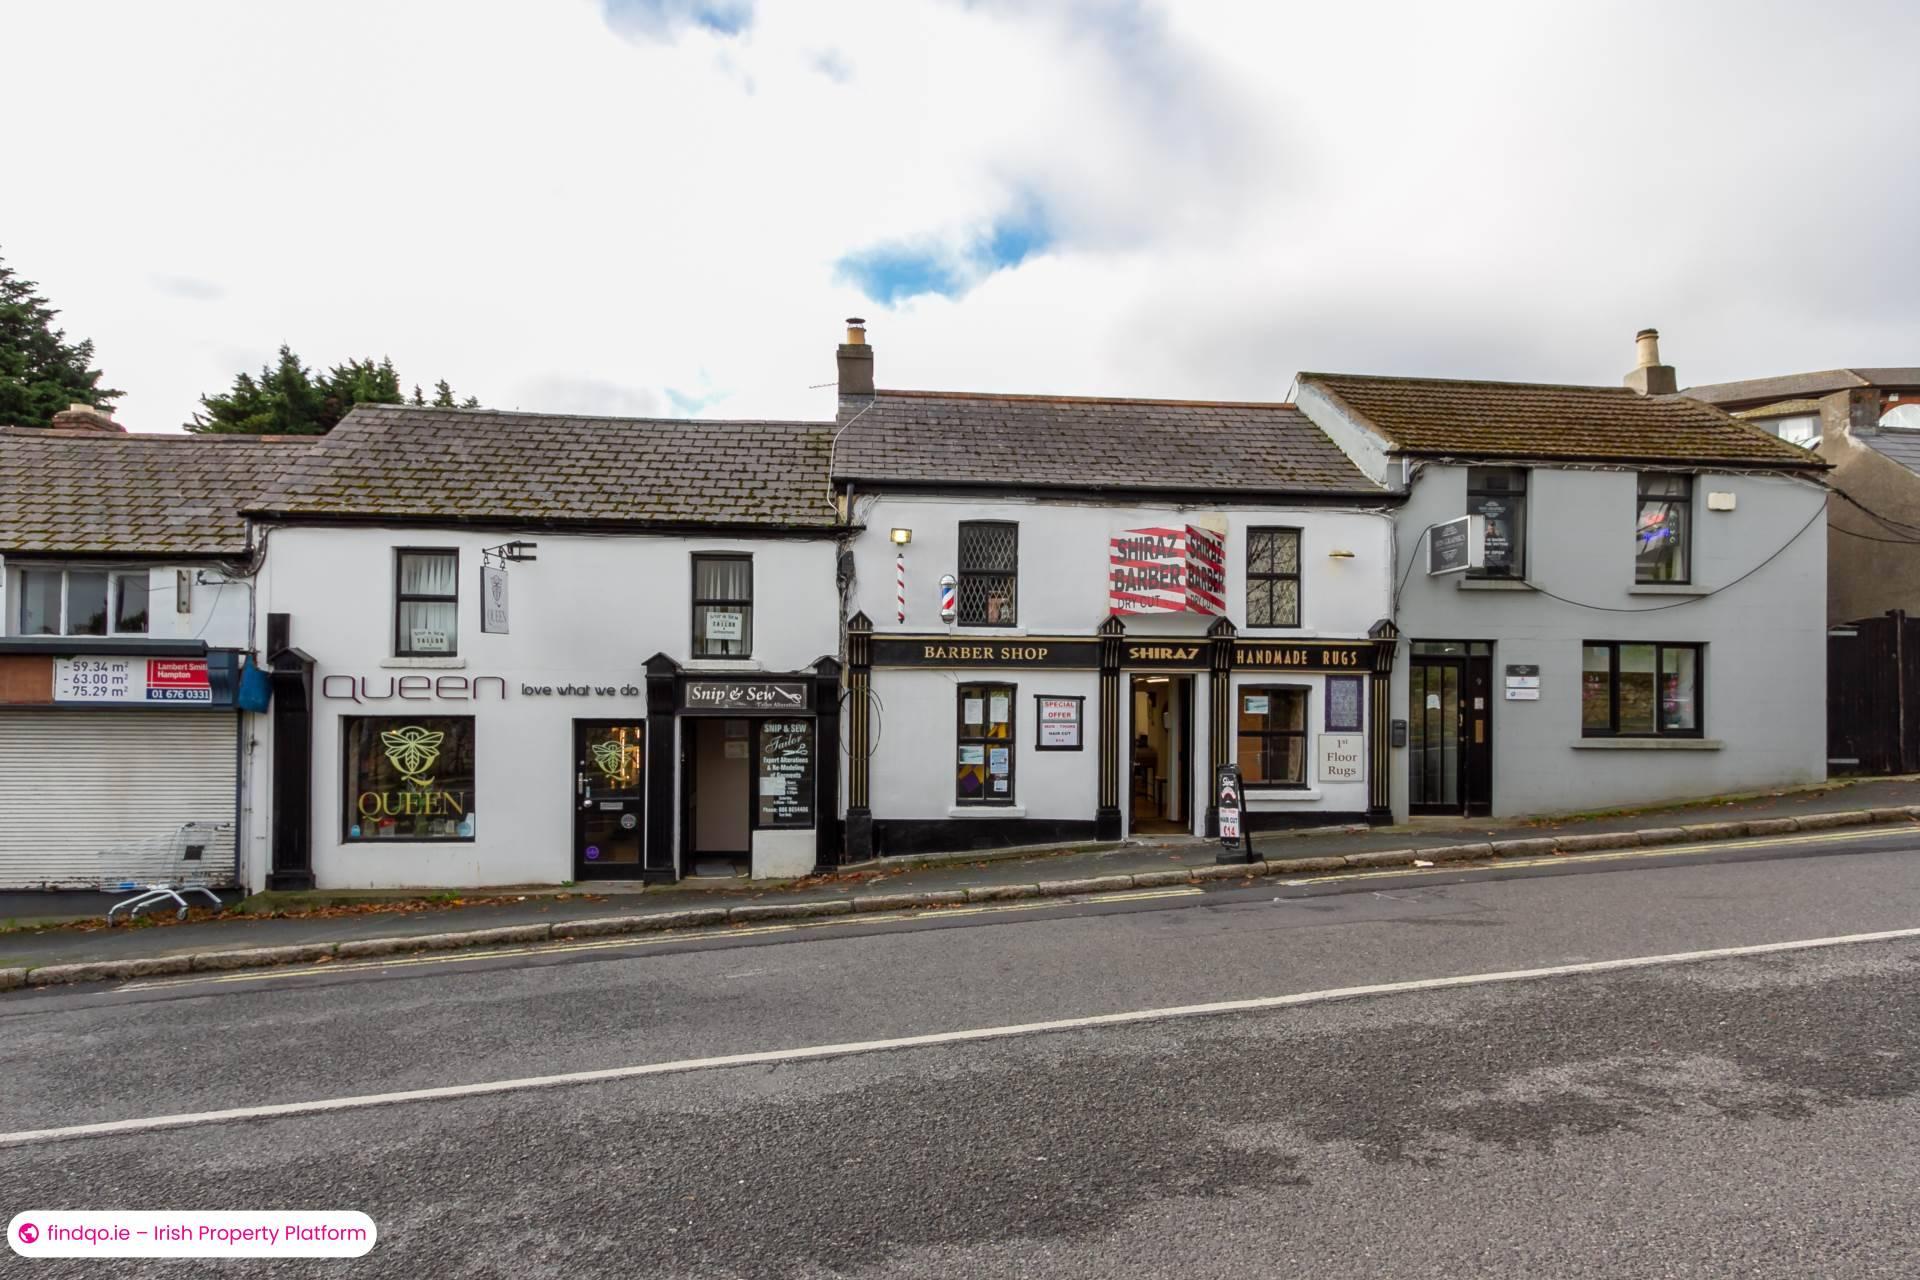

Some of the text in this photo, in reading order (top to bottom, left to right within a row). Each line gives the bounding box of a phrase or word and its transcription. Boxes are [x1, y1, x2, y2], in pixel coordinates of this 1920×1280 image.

[1117, 534, 1178, 561] SHIRAZ
[1190, 535, 1223, 564] SHIRAZ
[1114, 564, 1181, 592] BARBER
[1186, 562, 1225, 593] BARBER
[1118, 595, 1160, 609] DRY CUT
[924, 646, 1048, 660] BARBER SHOP
[1236, 649, 1357, 666] HANDMADE RUGS
[72, 661, 108, 672] 59.34
[157, 663, 188, 671] Lambert
[72, 673, 108, 685] 63.00
[157, 671, 191, 680] Hampton
[72, 686, 108, 697] 75.29
[152, 689, 209, 699] 01 676 0331
[521, 683, 639, 697] love what we do
[691, 686, 776, 704] Snip & Sew
[763, 724, 807, 733] SNIP & SEW
[765, 734, 803, 754] Tailor
[1336, 739, 1348, 748] 1st
[1327, 752, 1358, 762] Floor
[1328, 765, 1357, 778] Rugs
[358, 791, 465, 822] QUEEN
